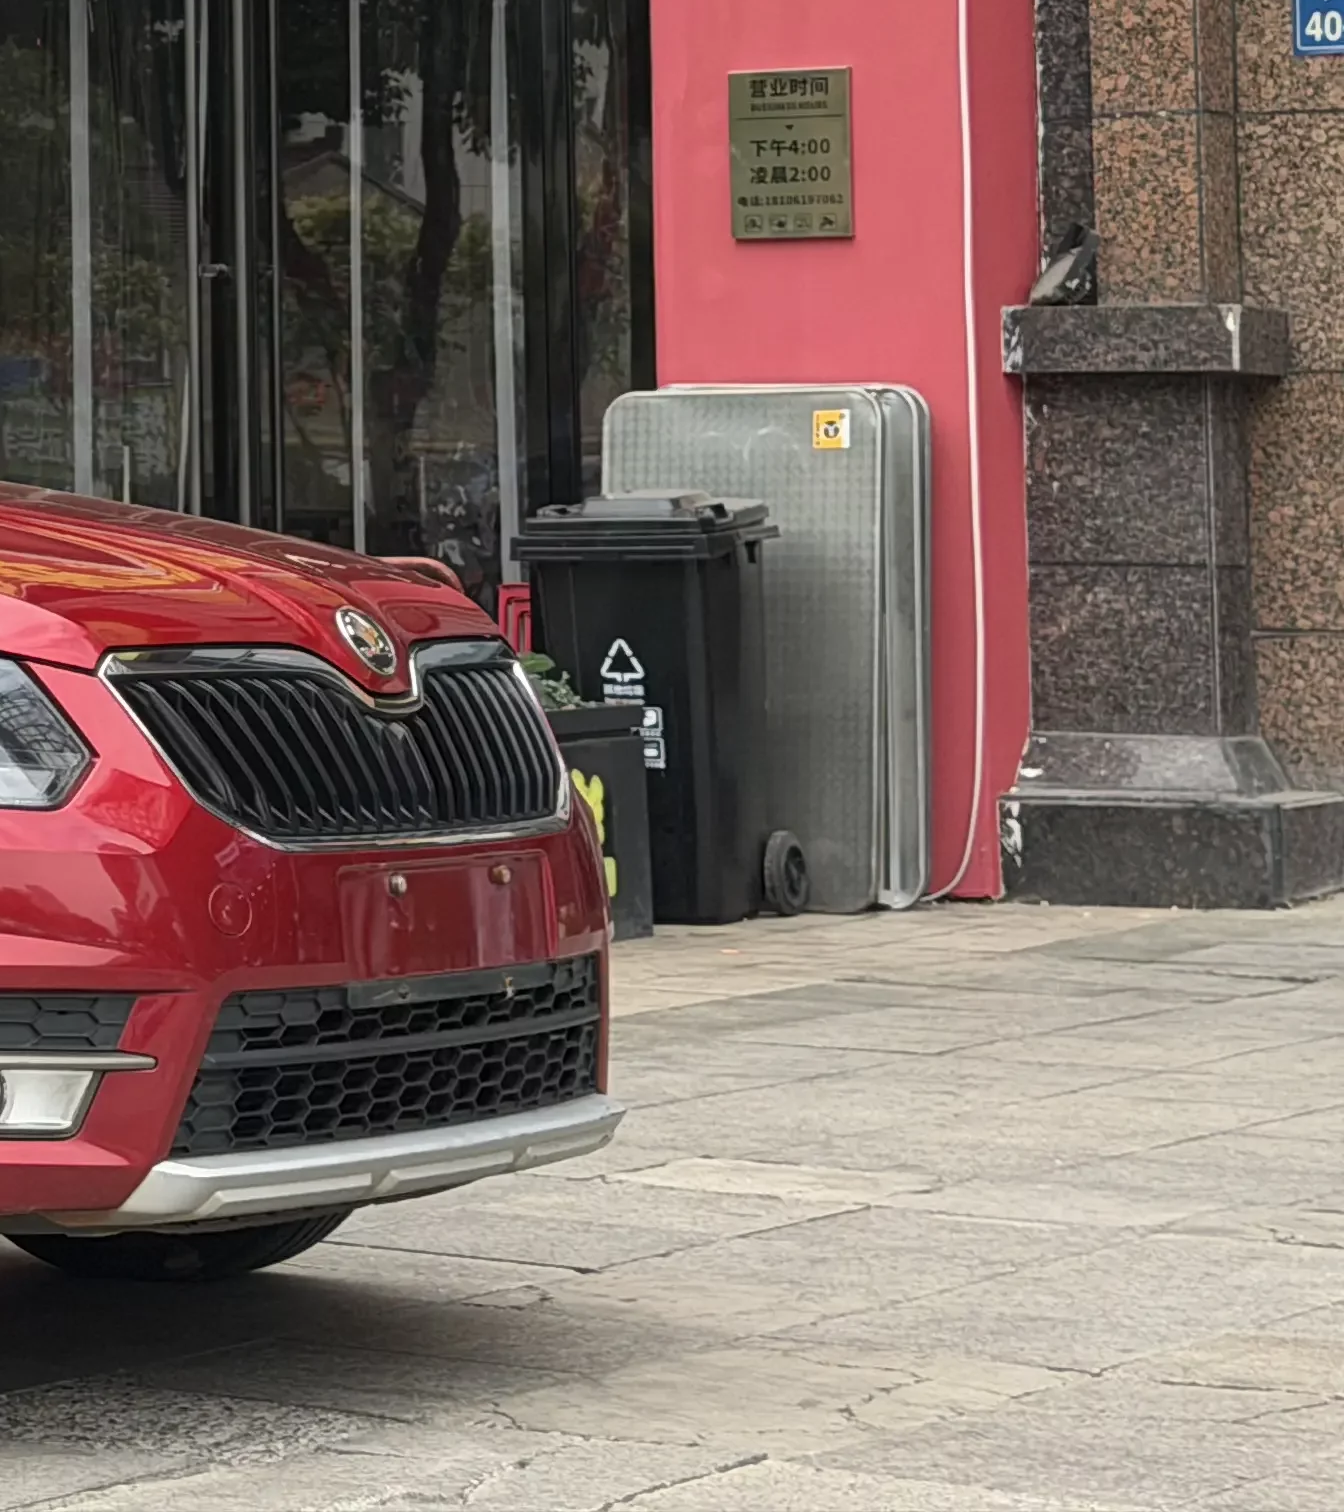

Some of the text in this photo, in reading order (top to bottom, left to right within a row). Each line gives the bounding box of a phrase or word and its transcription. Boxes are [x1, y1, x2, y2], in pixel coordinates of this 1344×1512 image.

[1305, 10, 1344, 42] 40
[749, 76, 829, 98] 营业时间
[749, 138, 831, 157] 下午4:00
[750, 166, 831, 184] 凌晨2:00
